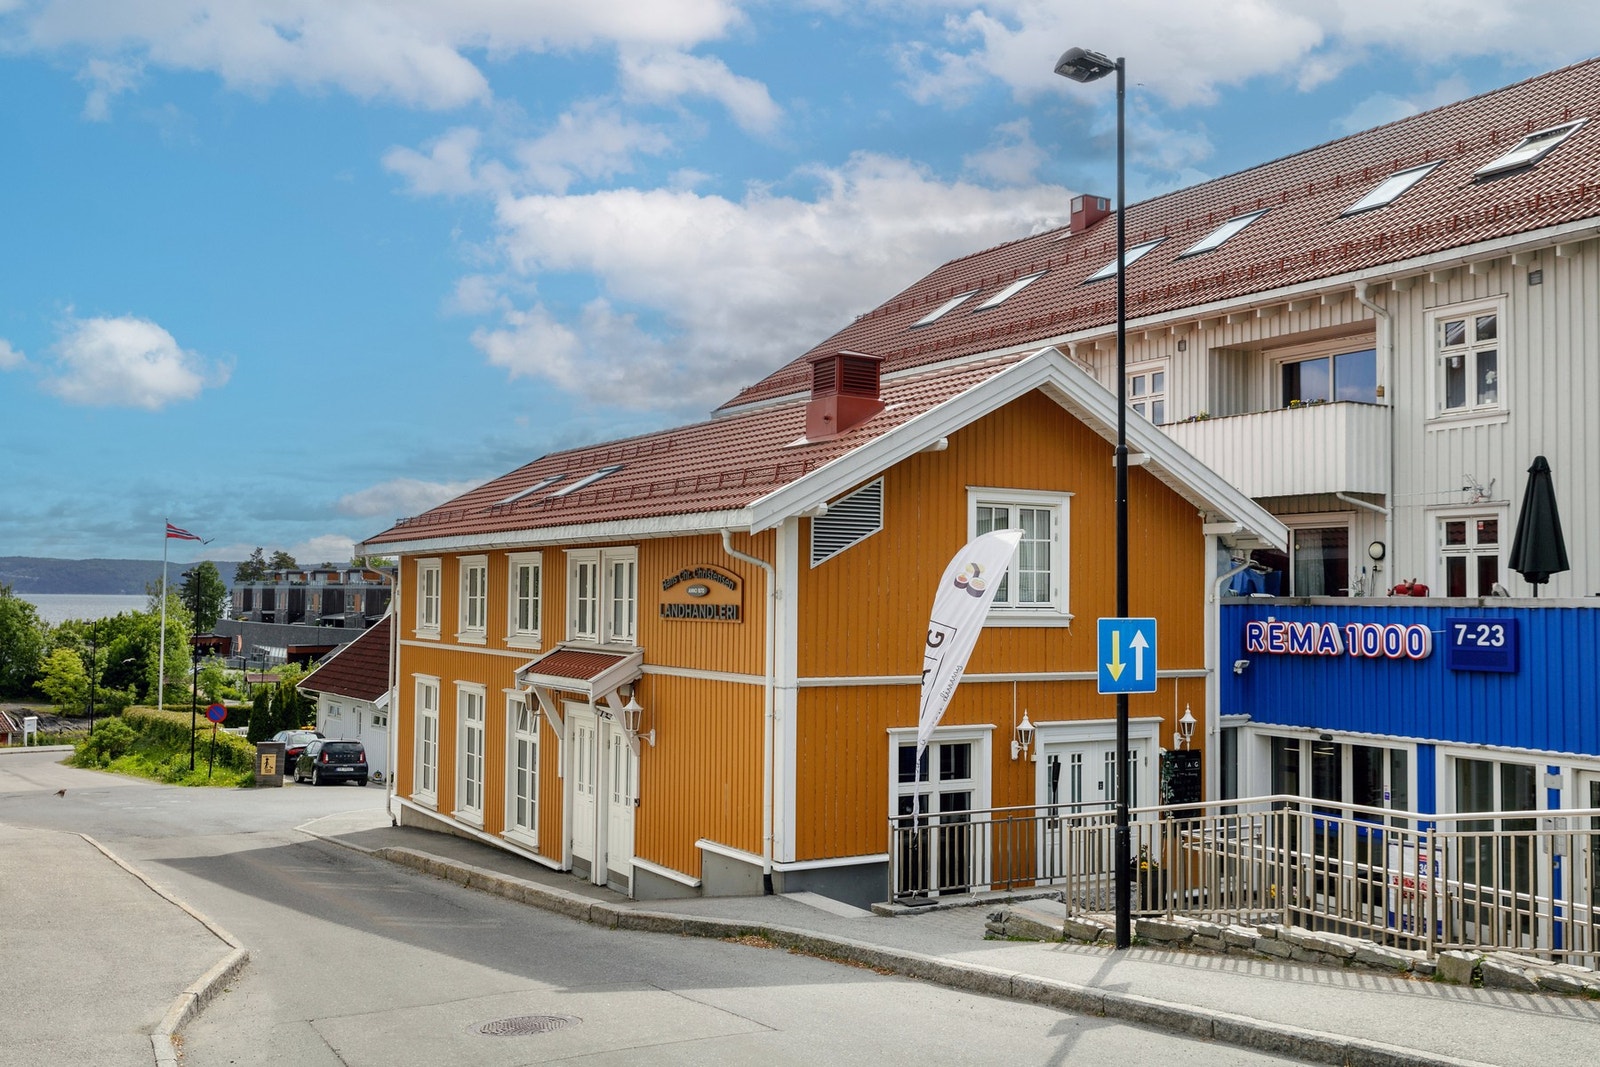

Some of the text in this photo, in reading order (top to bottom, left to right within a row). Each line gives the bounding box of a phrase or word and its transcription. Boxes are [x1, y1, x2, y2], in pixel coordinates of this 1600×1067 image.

[662, 567, 737, 591] Hans Chr. Christensen
[660, 603, 739, 620] LANDHANDLERI
[1246, 621, 1432, 660] REMA 1000
[1453, 624, 1505, 647] 7-23
